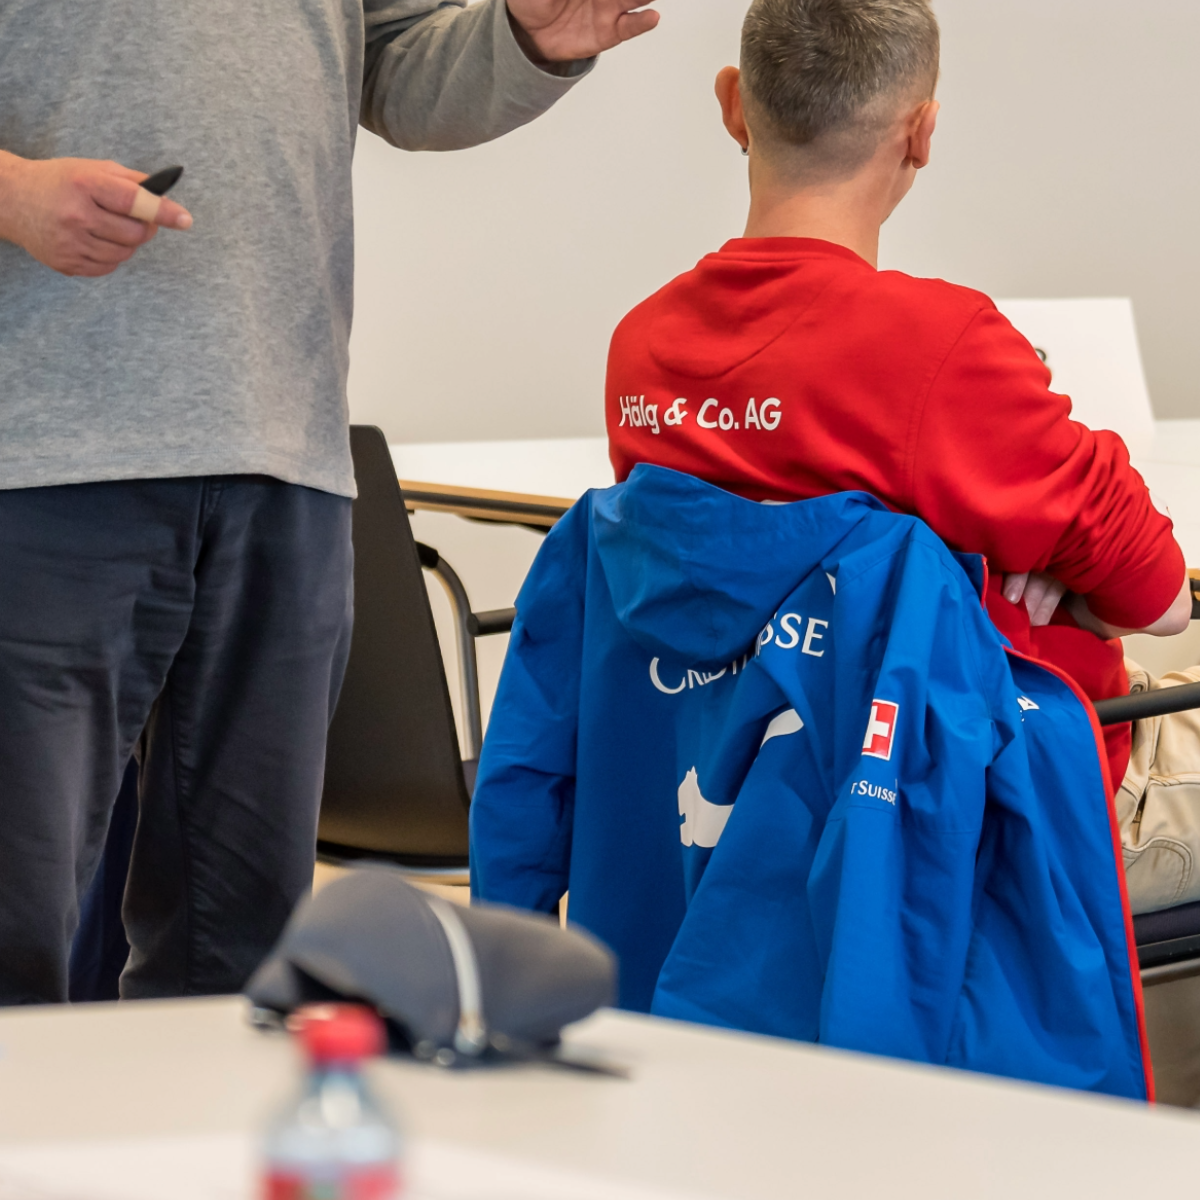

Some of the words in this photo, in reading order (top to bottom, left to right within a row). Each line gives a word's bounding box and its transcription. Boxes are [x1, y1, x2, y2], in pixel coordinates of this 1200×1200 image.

[619, 395, 660, 434] Hälg
[663, 397, 688, 426] &
[696, 398, 739, 431] Co.
[744, 397, 782, 431] AG
